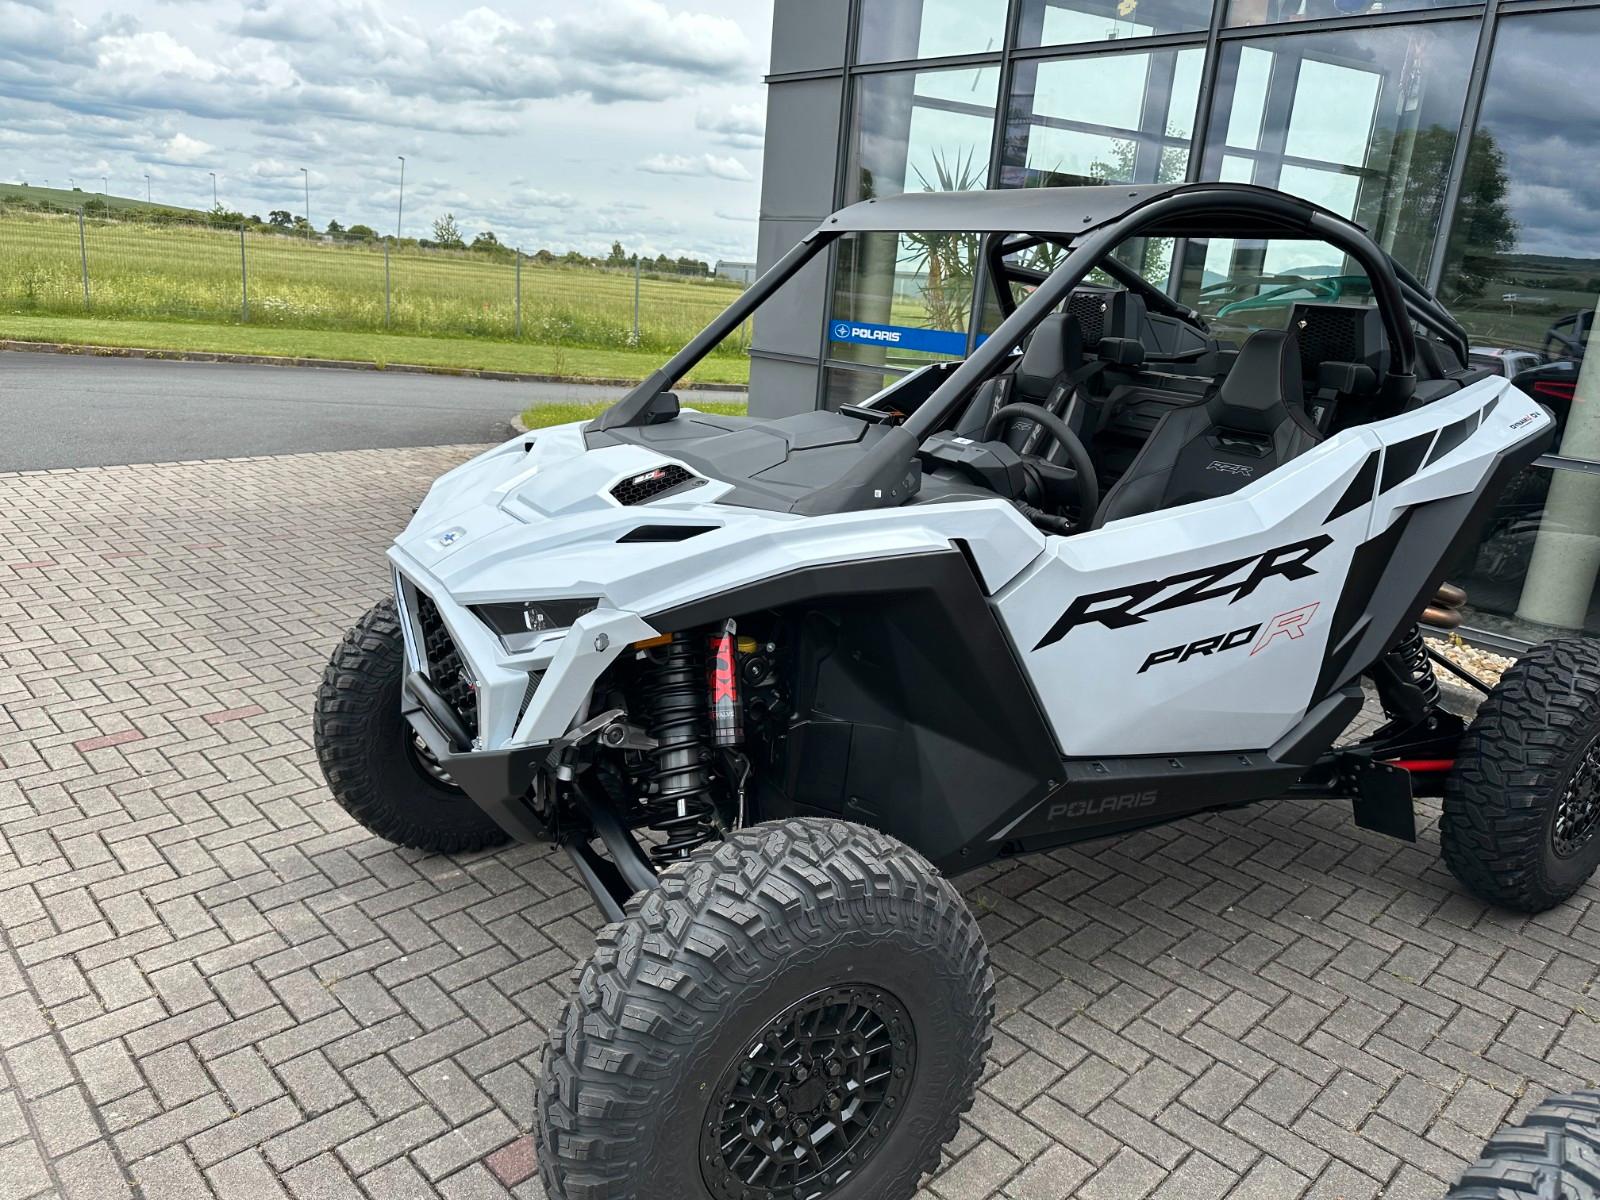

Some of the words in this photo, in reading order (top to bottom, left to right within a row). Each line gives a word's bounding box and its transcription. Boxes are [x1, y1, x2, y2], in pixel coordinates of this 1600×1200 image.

[852, 327, 900, 342] POLARIS
[1205, 460, 1254, 477] RZR
[1030, 533, 1335, 652] RZR
[1136, 622, 1263, 674] PRO
[1250, 602, 1320, 656] R
[1047, 790, 1159, 820] POLARIS
